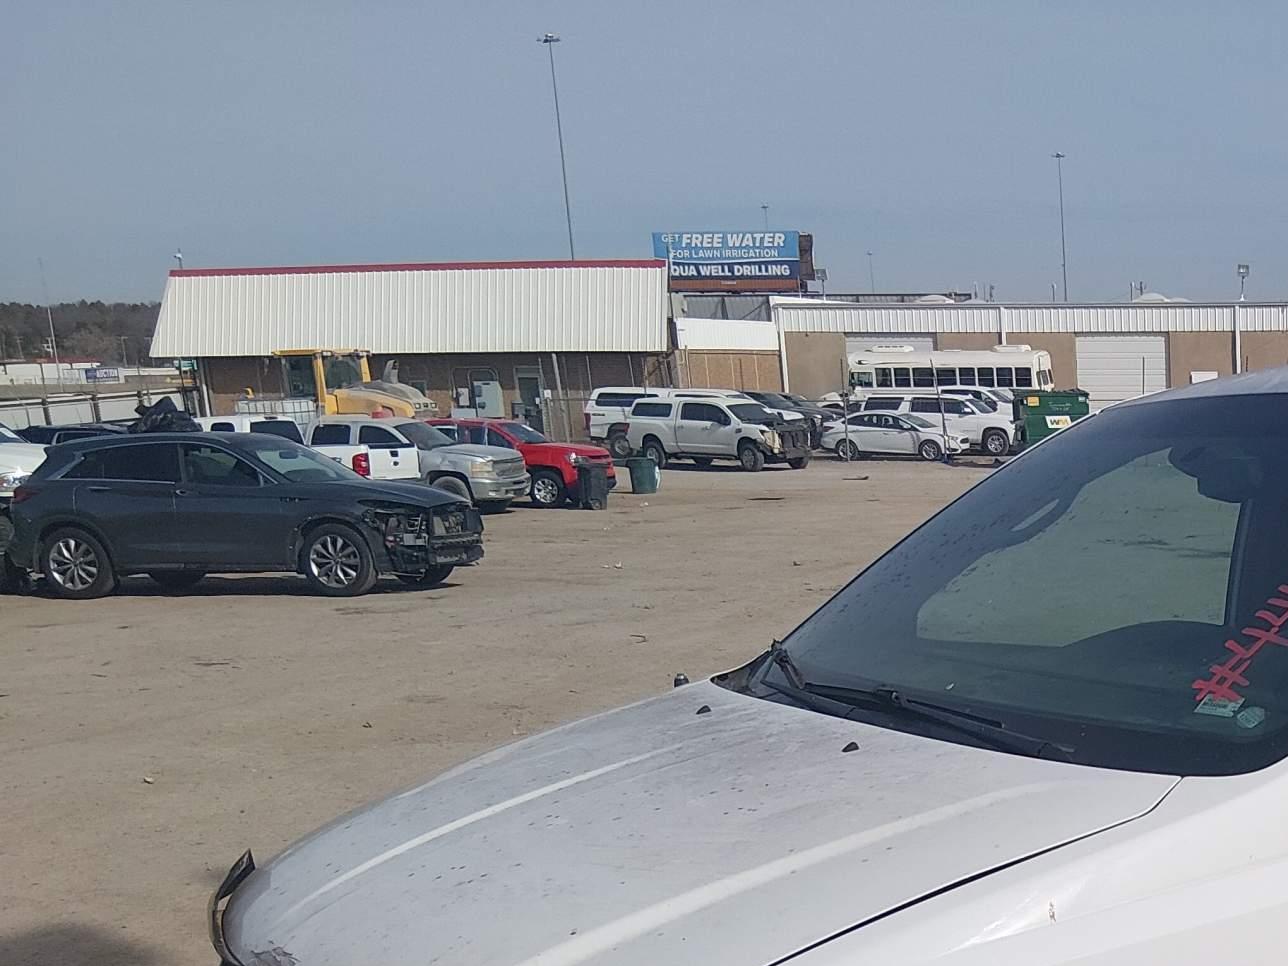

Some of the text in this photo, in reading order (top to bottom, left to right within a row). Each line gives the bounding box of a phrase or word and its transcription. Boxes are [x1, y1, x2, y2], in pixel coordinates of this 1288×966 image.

[661, 232, 786, 248] GET FREE WATER
[671, 248, 779, 258] FOR LAWN IRRIGATION
[671, 263, 791, 277] QUA WELL DRILLING
[1049, 417, 1070, 426] WM
